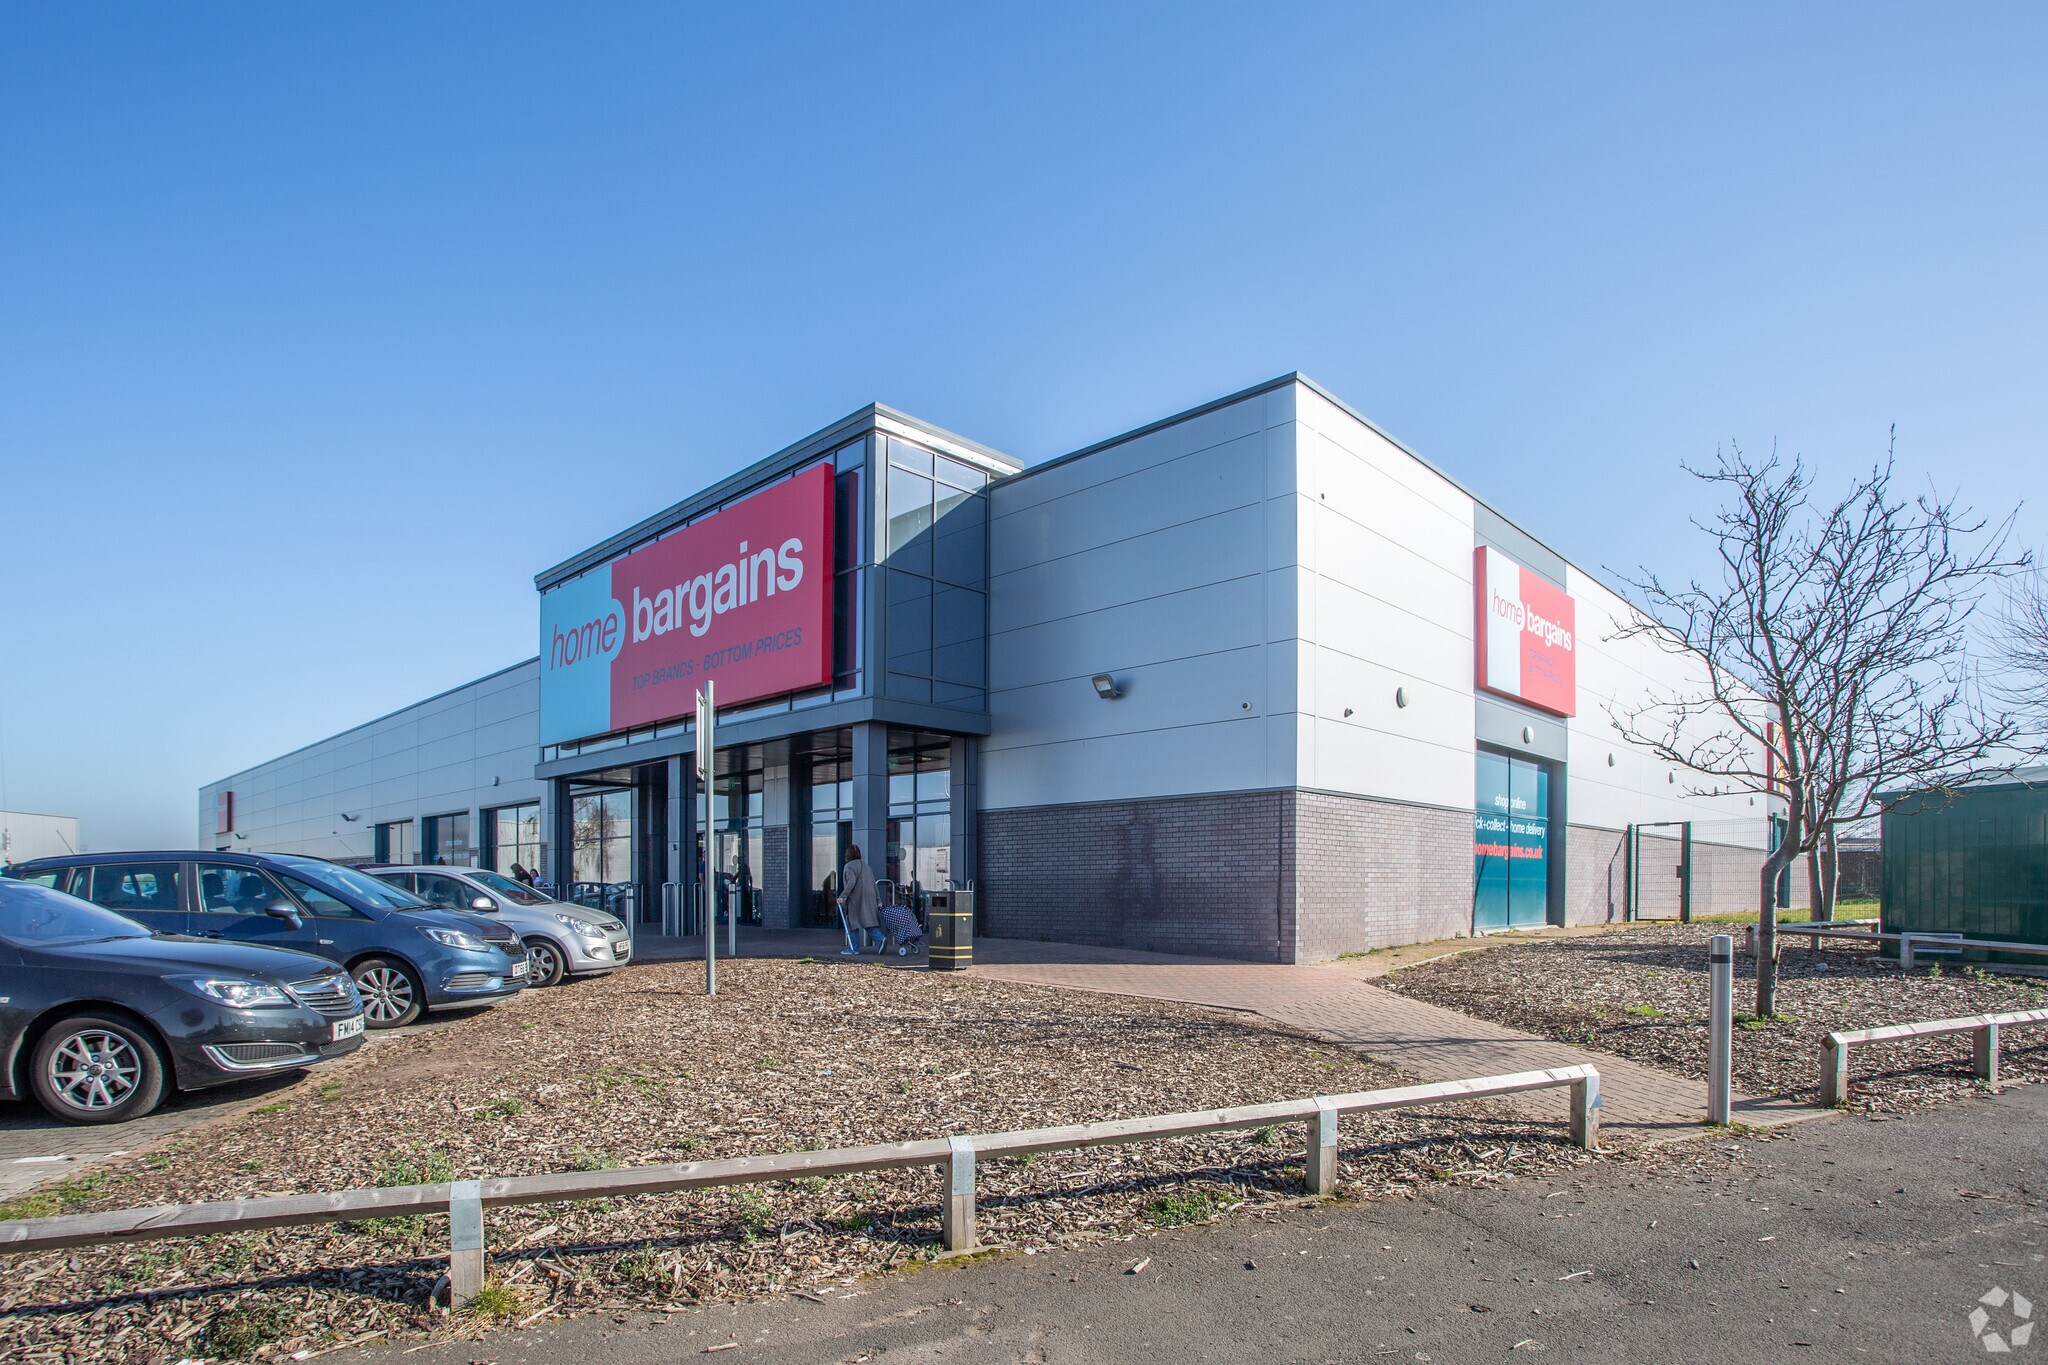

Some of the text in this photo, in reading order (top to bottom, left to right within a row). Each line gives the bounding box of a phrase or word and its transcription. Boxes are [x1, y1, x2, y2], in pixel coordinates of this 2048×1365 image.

[550, 537, 804, 670] home bargains
[1493, 588, 1572, 651] home bargains
[632, 673, 650, 690] TOP
[652, 660, 694, 686] BRANDS
[703, 642, 753, 671] BOTTOM
[755, 627, 802, 656] PRICES
[1495, 794, 1526, 810] shop online
[1510, 820, 1525, 834] home
[1526, 822, 1546, 839] delivery
